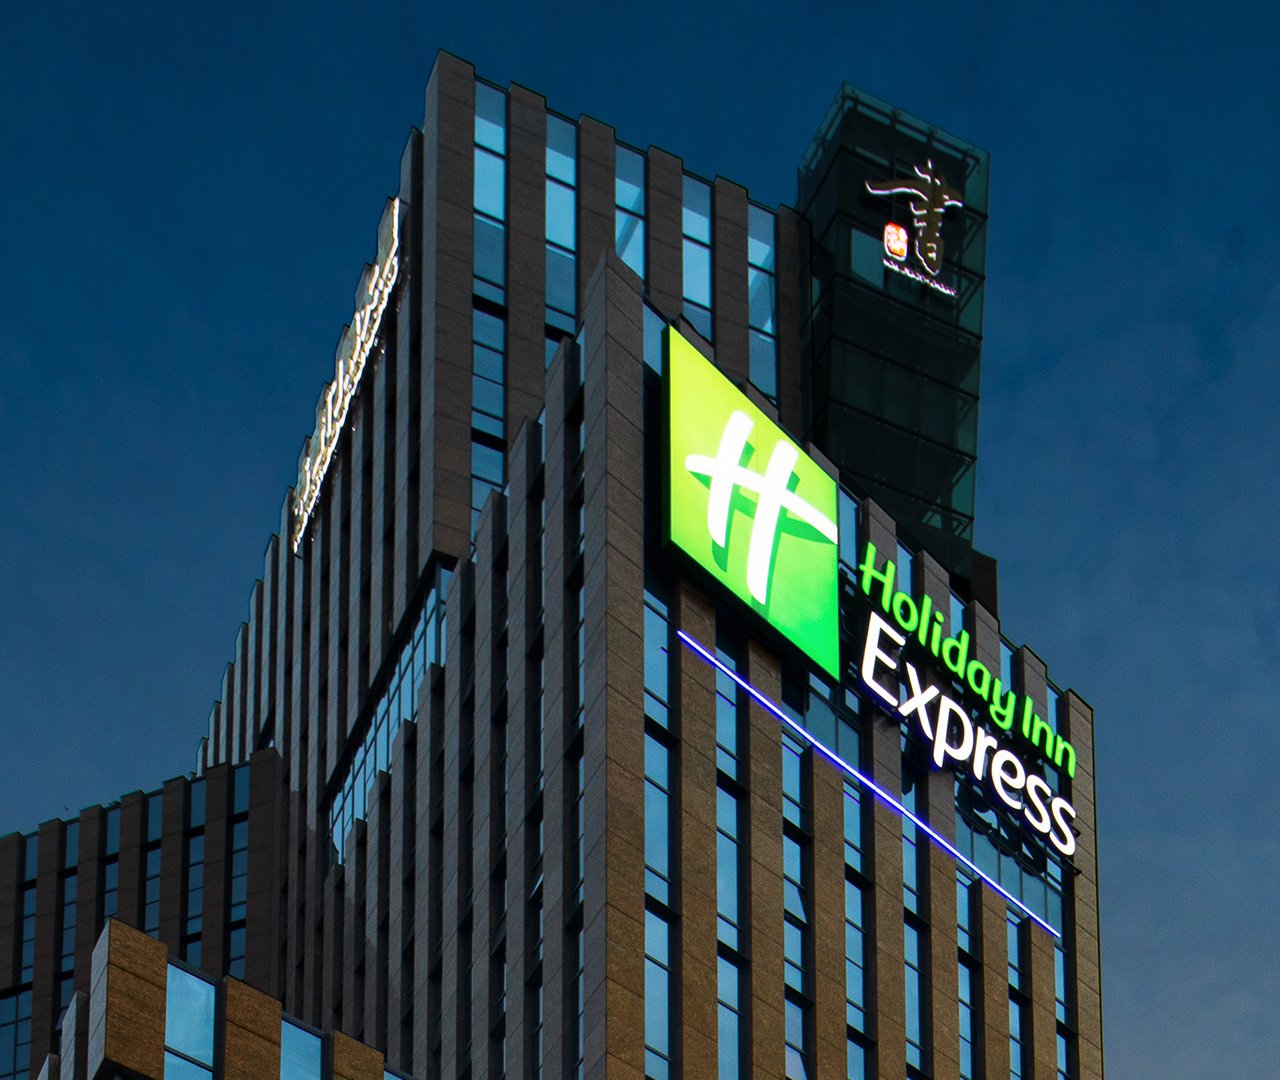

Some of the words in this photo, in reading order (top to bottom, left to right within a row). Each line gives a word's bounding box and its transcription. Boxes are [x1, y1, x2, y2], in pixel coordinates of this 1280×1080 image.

[859, 542, 1016, 731] Holiday
[1022, 701, 1077, 778] Inn
[861, 611, 1077, 857] Express
